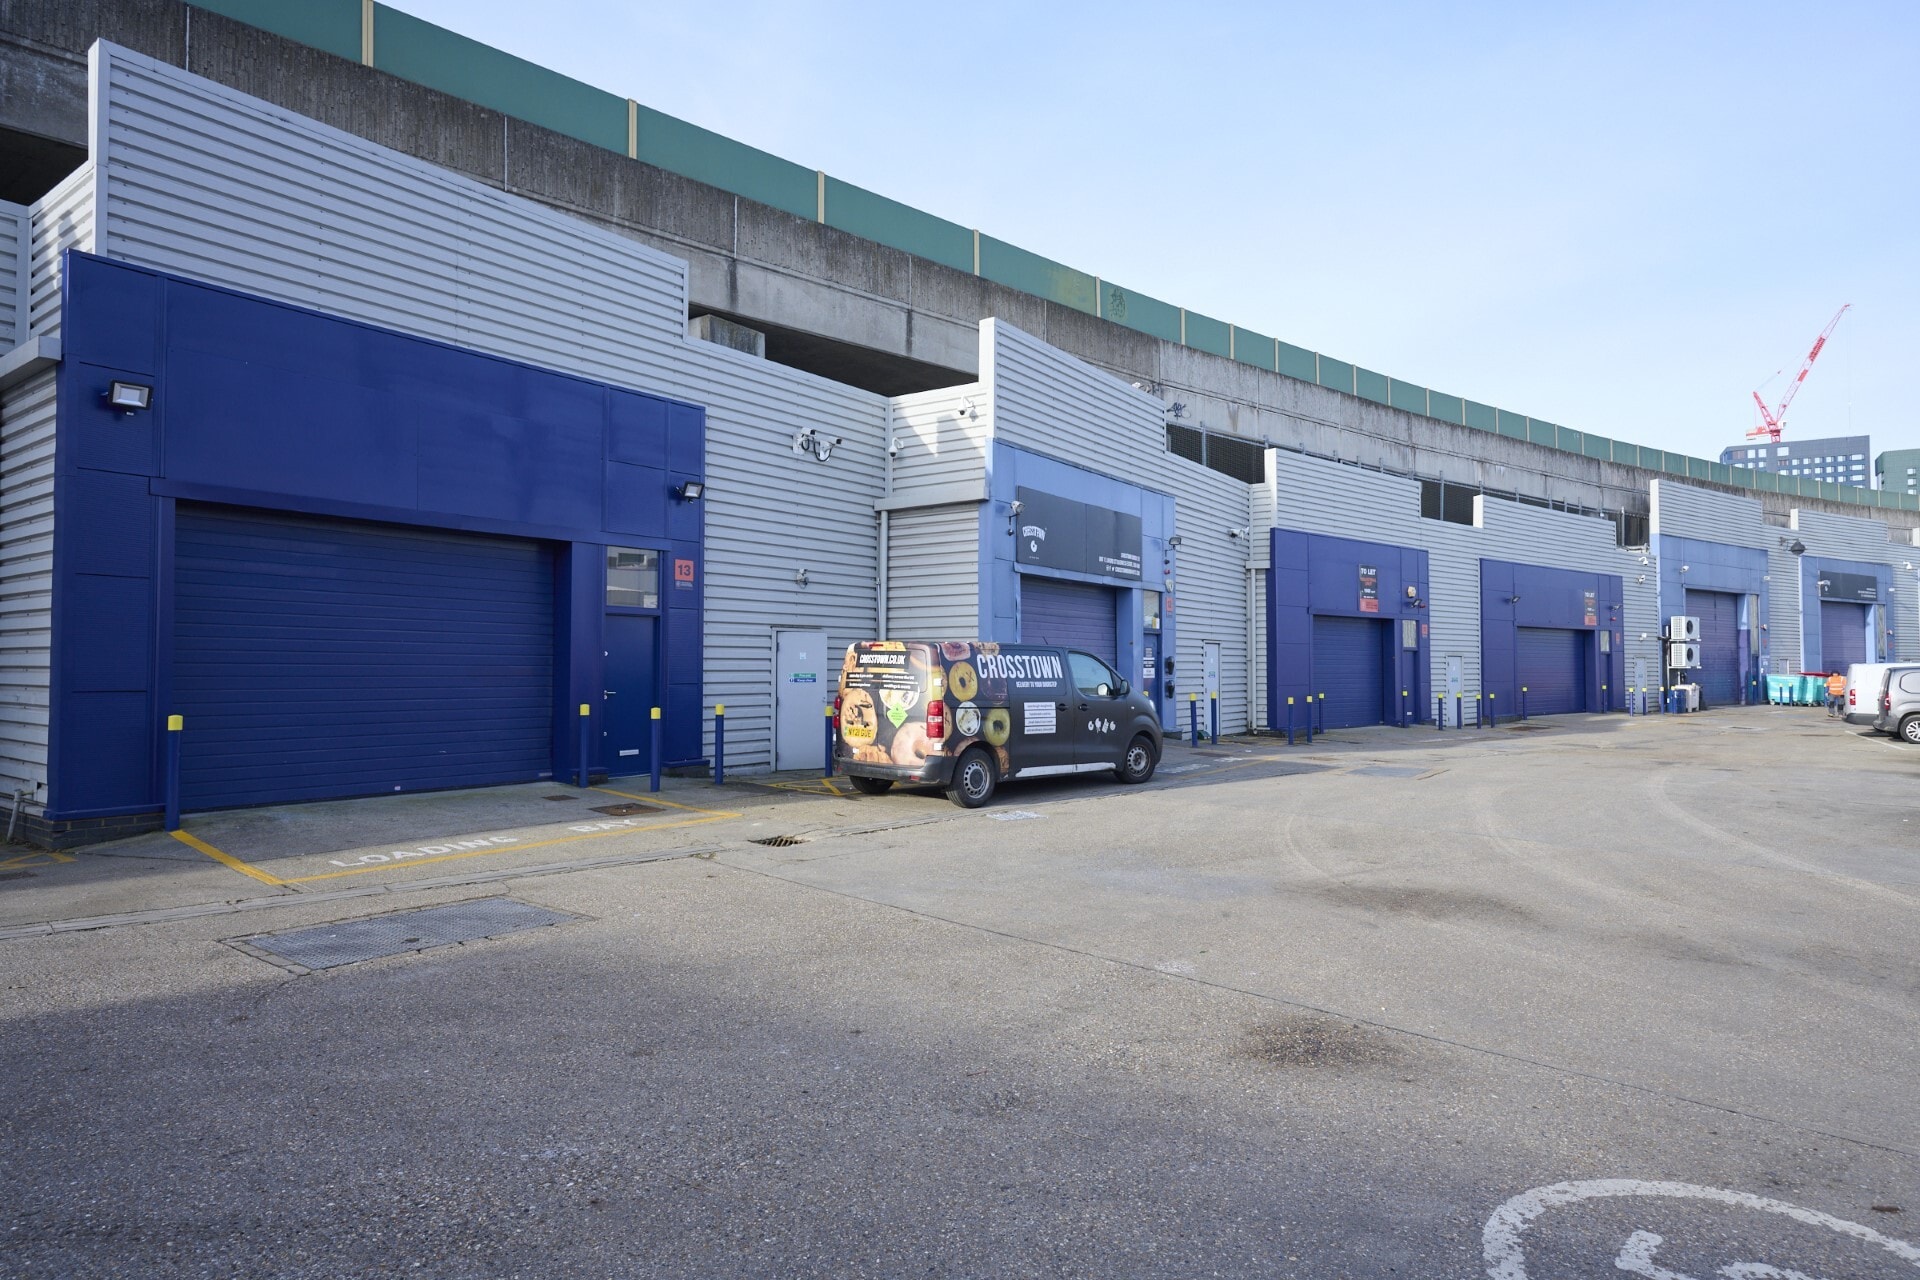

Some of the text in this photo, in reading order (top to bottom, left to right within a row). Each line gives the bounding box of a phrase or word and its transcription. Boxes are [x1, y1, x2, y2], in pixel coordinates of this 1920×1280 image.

[678, 564, 691, 576] 13
[1367, 568, 1377, 576] LET
[976, 654, 1063, 679] CROSSTOWN
[329, 819, 638, 868] LOADING BAY
